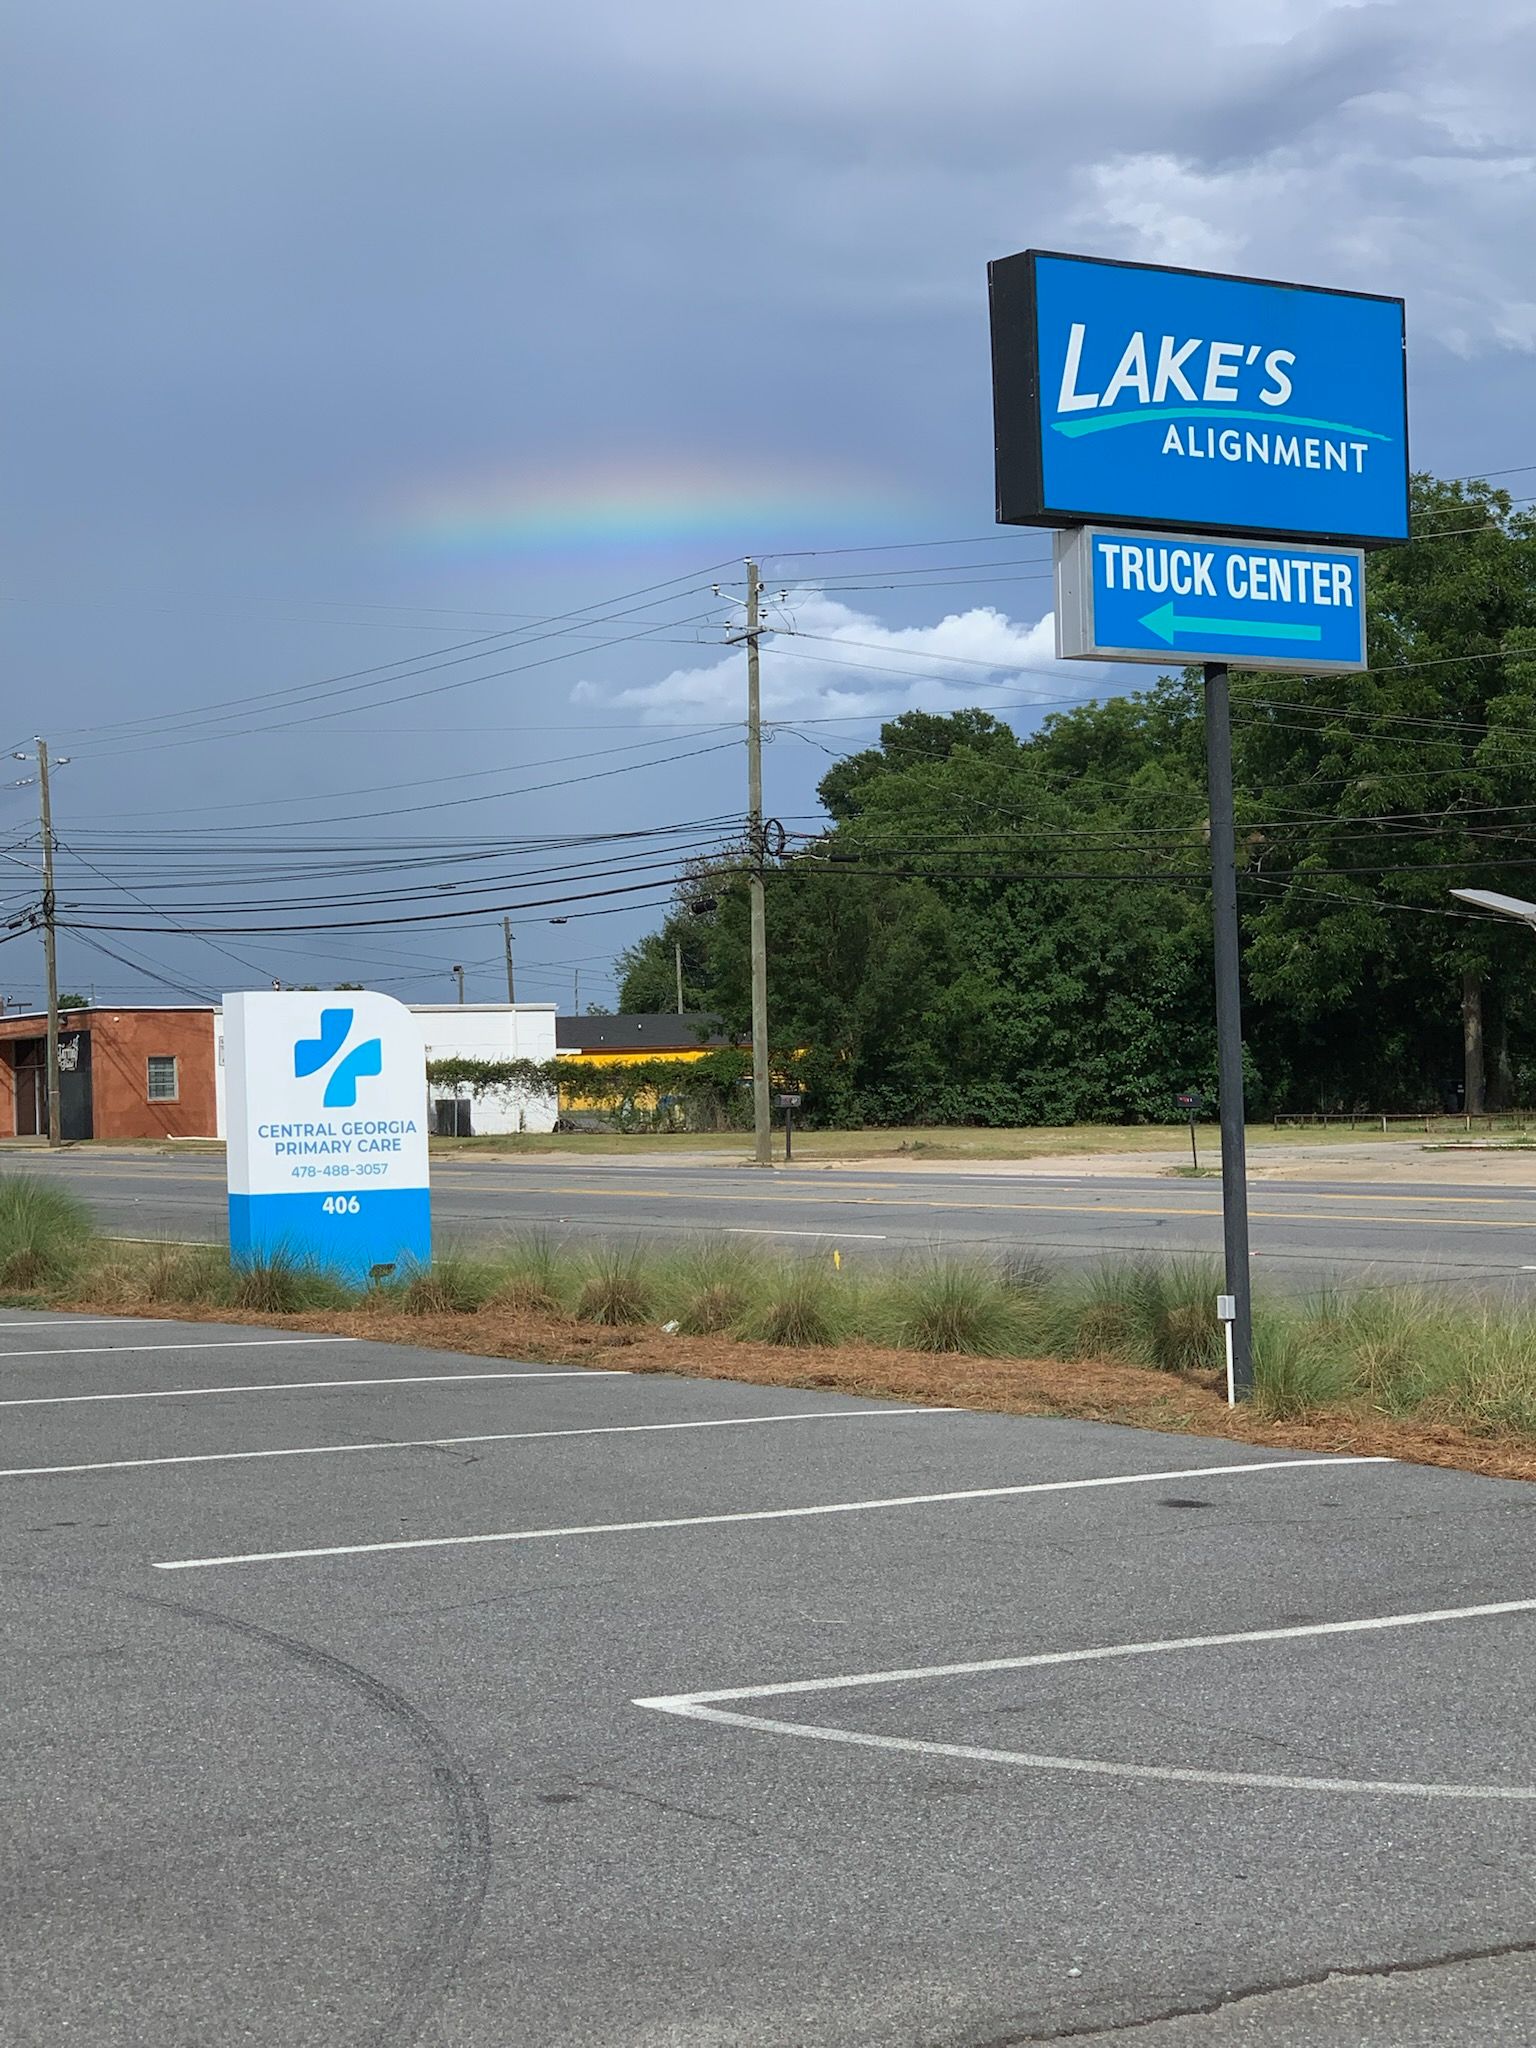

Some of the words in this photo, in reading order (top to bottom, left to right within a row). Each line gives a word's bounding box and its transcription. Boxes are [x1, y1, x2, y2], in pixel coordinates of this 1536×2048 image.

[1057, 323, 1296, 413] LAKE'S
[1162, 424, 1368, 473] ALIGNMENT
[1098, 543, 1217, 597] TRUCK
[1225, 553, 1354, 607] CENTER
[258, 1123, 337, 1138] CENTRAL
[341, 1120, 417, 1136] GEORGIA
[275, 1140, 352, 1156] PRIMARY
[357, 1138, 402, 1153] CARE
[291, 1163, 388, 1178] 478-488-3057
[322, 1195, 361, 1215] 406
